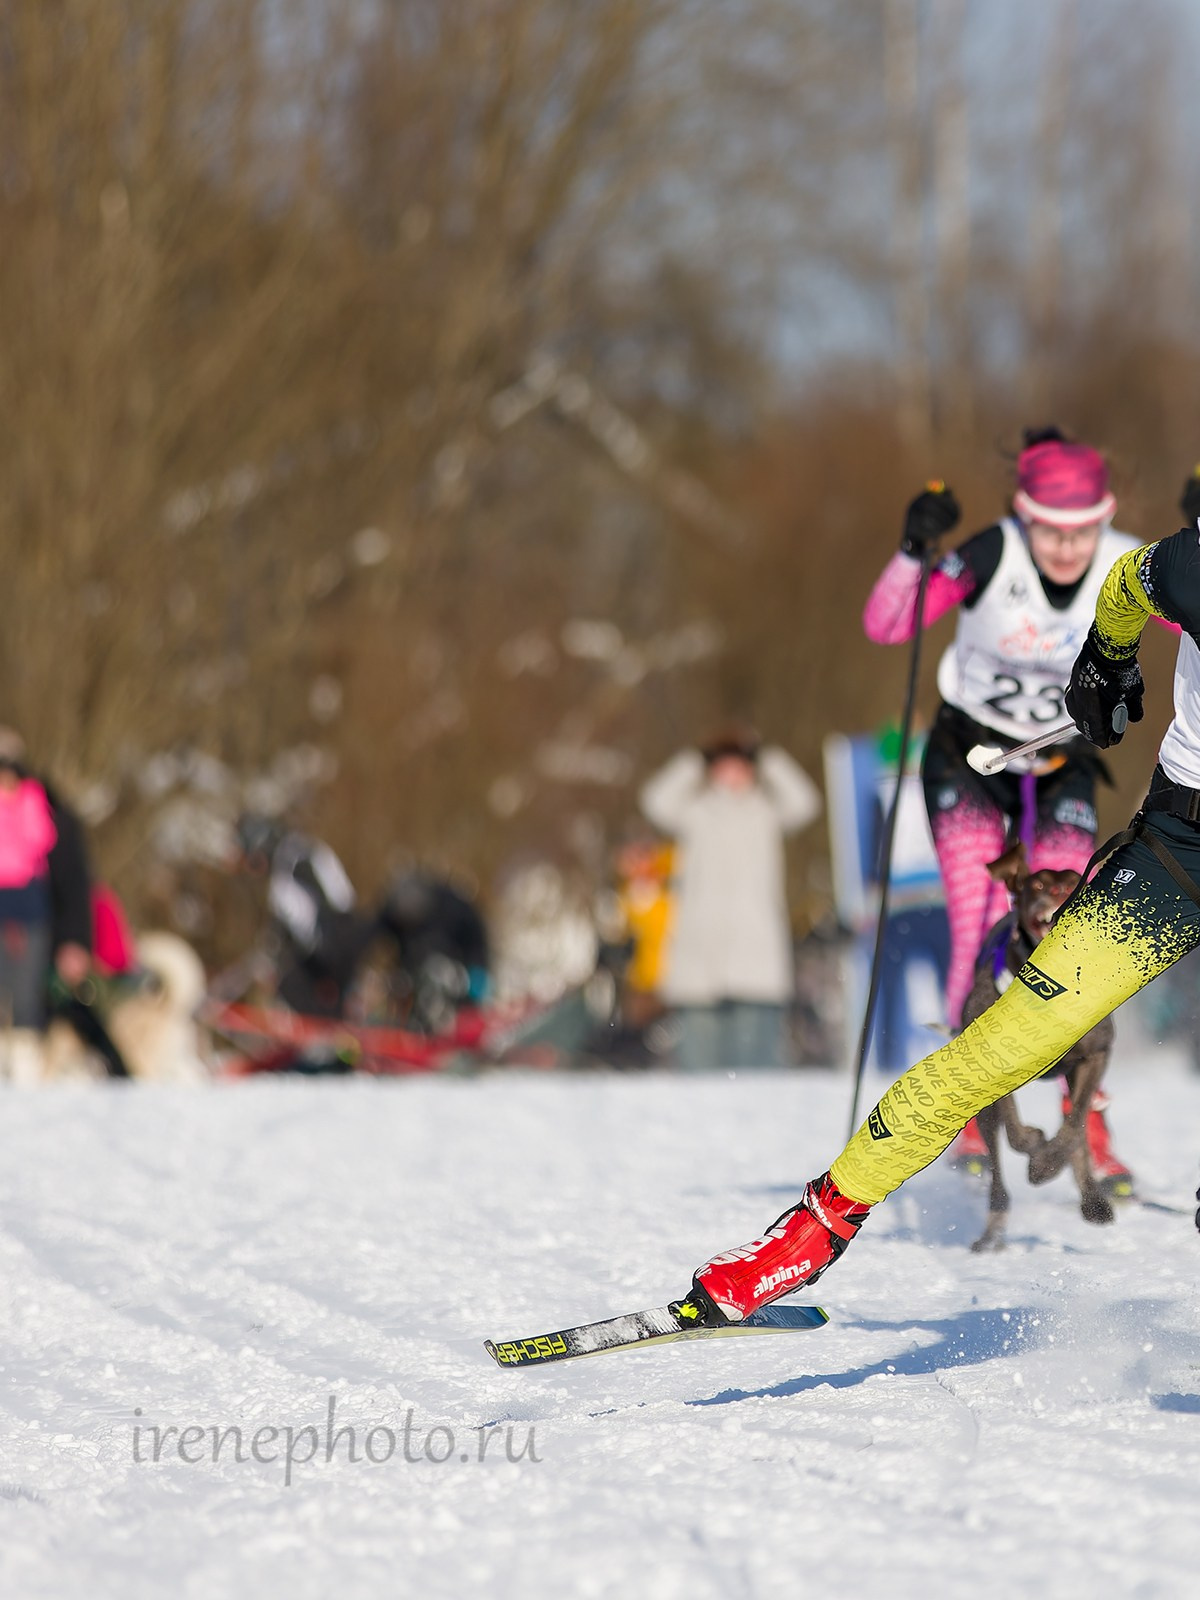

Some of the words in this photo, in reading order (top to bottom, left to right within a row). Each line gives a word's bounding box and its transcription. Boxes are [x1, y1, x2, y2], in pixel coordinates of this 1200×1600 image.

[1086, 663, 1108, 687] MOAX
[984, 674, 1064, 723] 23
[983, 1013, 1003, 1034] AND
[1000, 1036, 1037, 1059] GET
[892, 1080, 912, 1108] GET
[907, 1076, 935, 1107] AND
[934, 1108, 968, 1123] GET
[946, 1067, 990, 1098] HAVE
[941, 1091, 979, 1111] FUN
[880, 1095, 936, 1147] RESULTS
[811, 1193, 833, 1229] alpina
[753, 1258, 812, 1299] alpina
[497, 1333, 567, 1363] FISCHER
